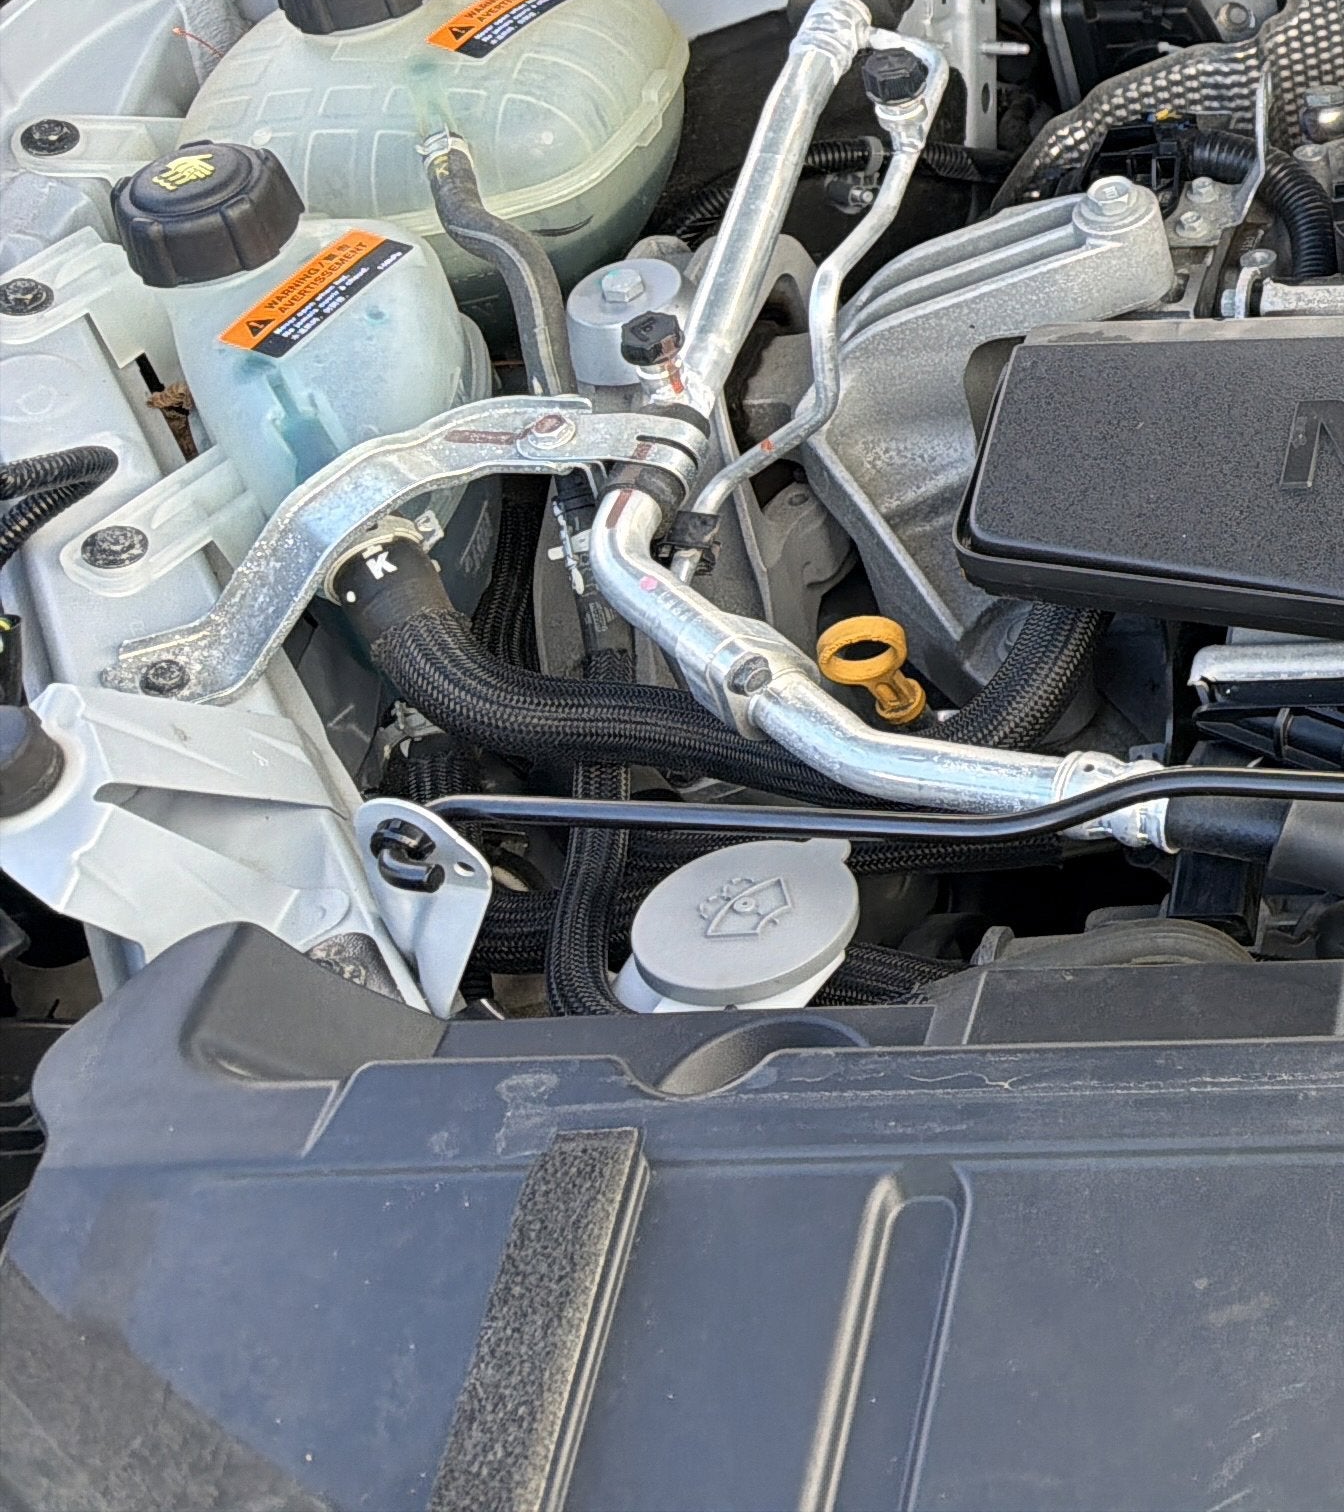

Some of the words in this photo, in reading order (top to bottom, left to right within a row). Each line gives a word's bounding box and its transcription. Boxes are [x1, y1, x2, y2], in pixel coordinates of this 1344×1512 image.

[264, 267, 319, 309] WARNING
[279, 241, 368, 313] AVERTISSEMENT
[365, 551, 398, 580] K
